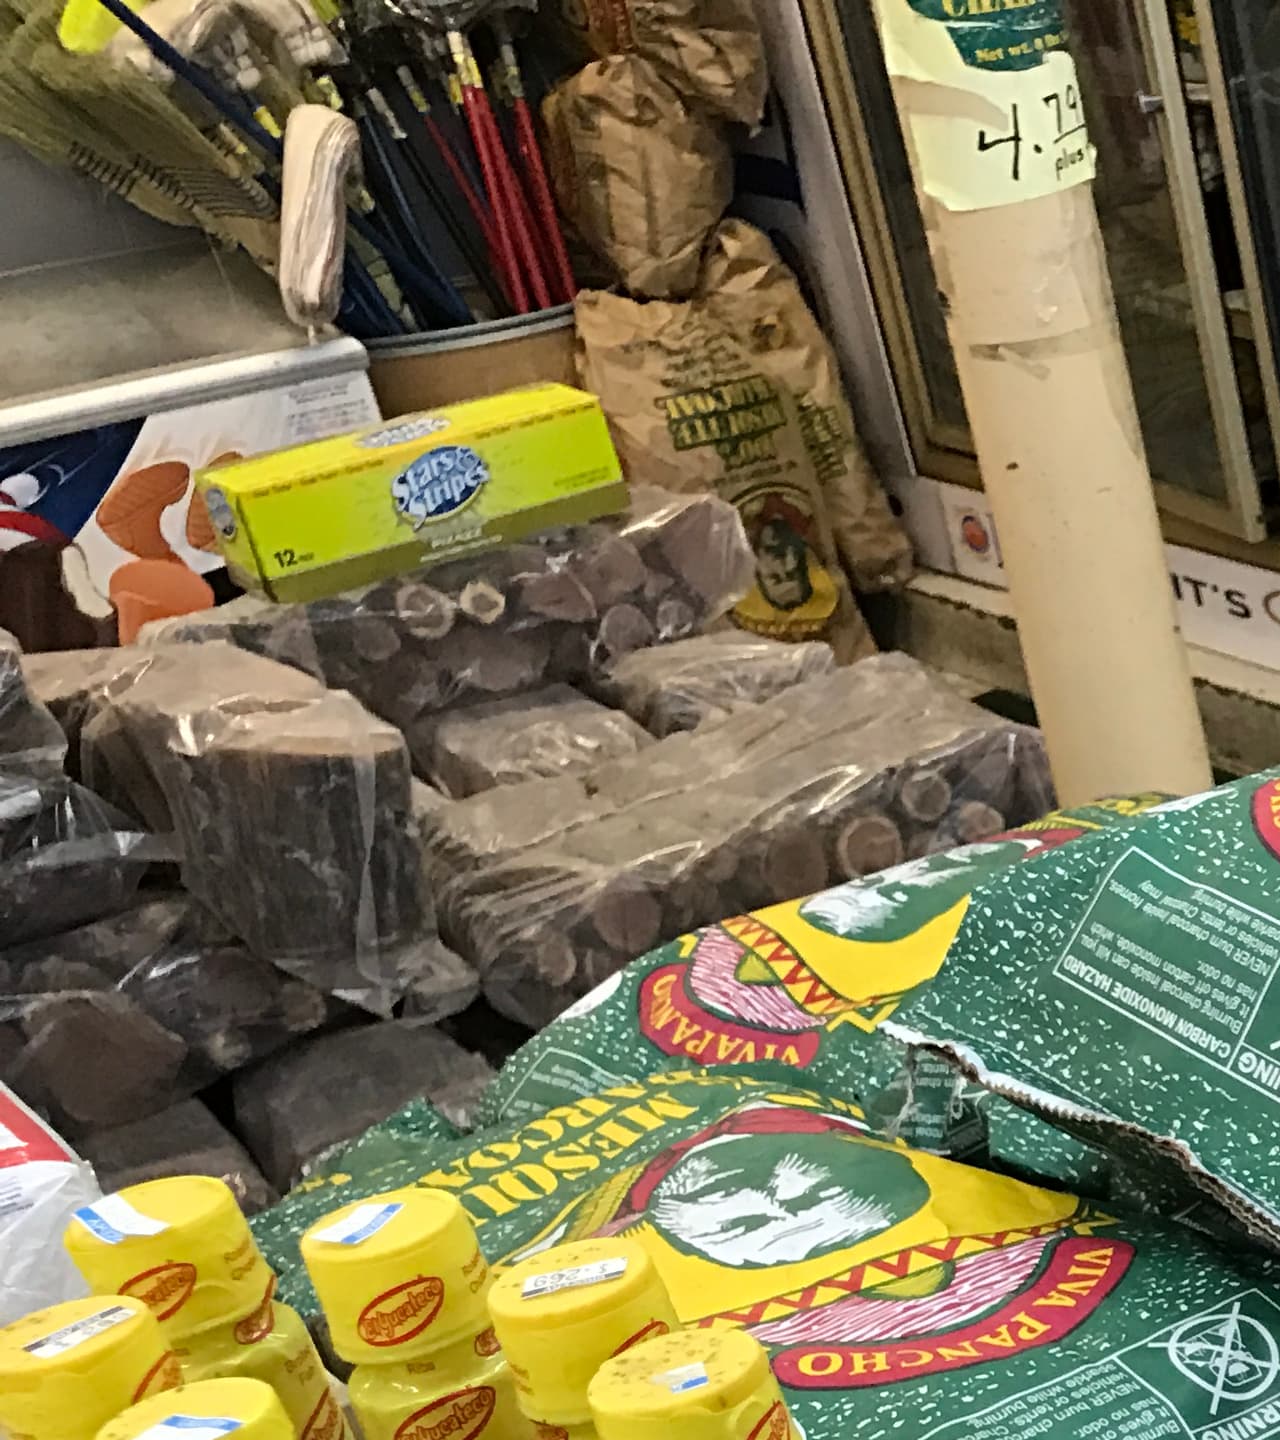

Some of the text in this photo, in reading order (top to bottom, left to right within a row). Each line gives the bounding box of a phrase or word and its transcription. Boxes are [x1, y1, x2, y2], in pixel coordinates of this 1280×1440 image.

[392, 454, 454, 503] Stars
[407, 464, 489, 532] Stripes
[273, 549, 298, 568] 12
[1170, 572, 1252, 619] IT'S
[1059, 952, 1114, 992] HAZARD
[1108, 980, 1179, 1029] MONOXIDE
[1172, 1017, 1233, 1059] CARBON
[797, 1244, 1117, 1378] VIVA PANCHO
[1054, 1399, 1090, 1424] burn
[1087, 1376, 1140, 1409] NEVER
[1118, 1406, 1159, 1436] gives
